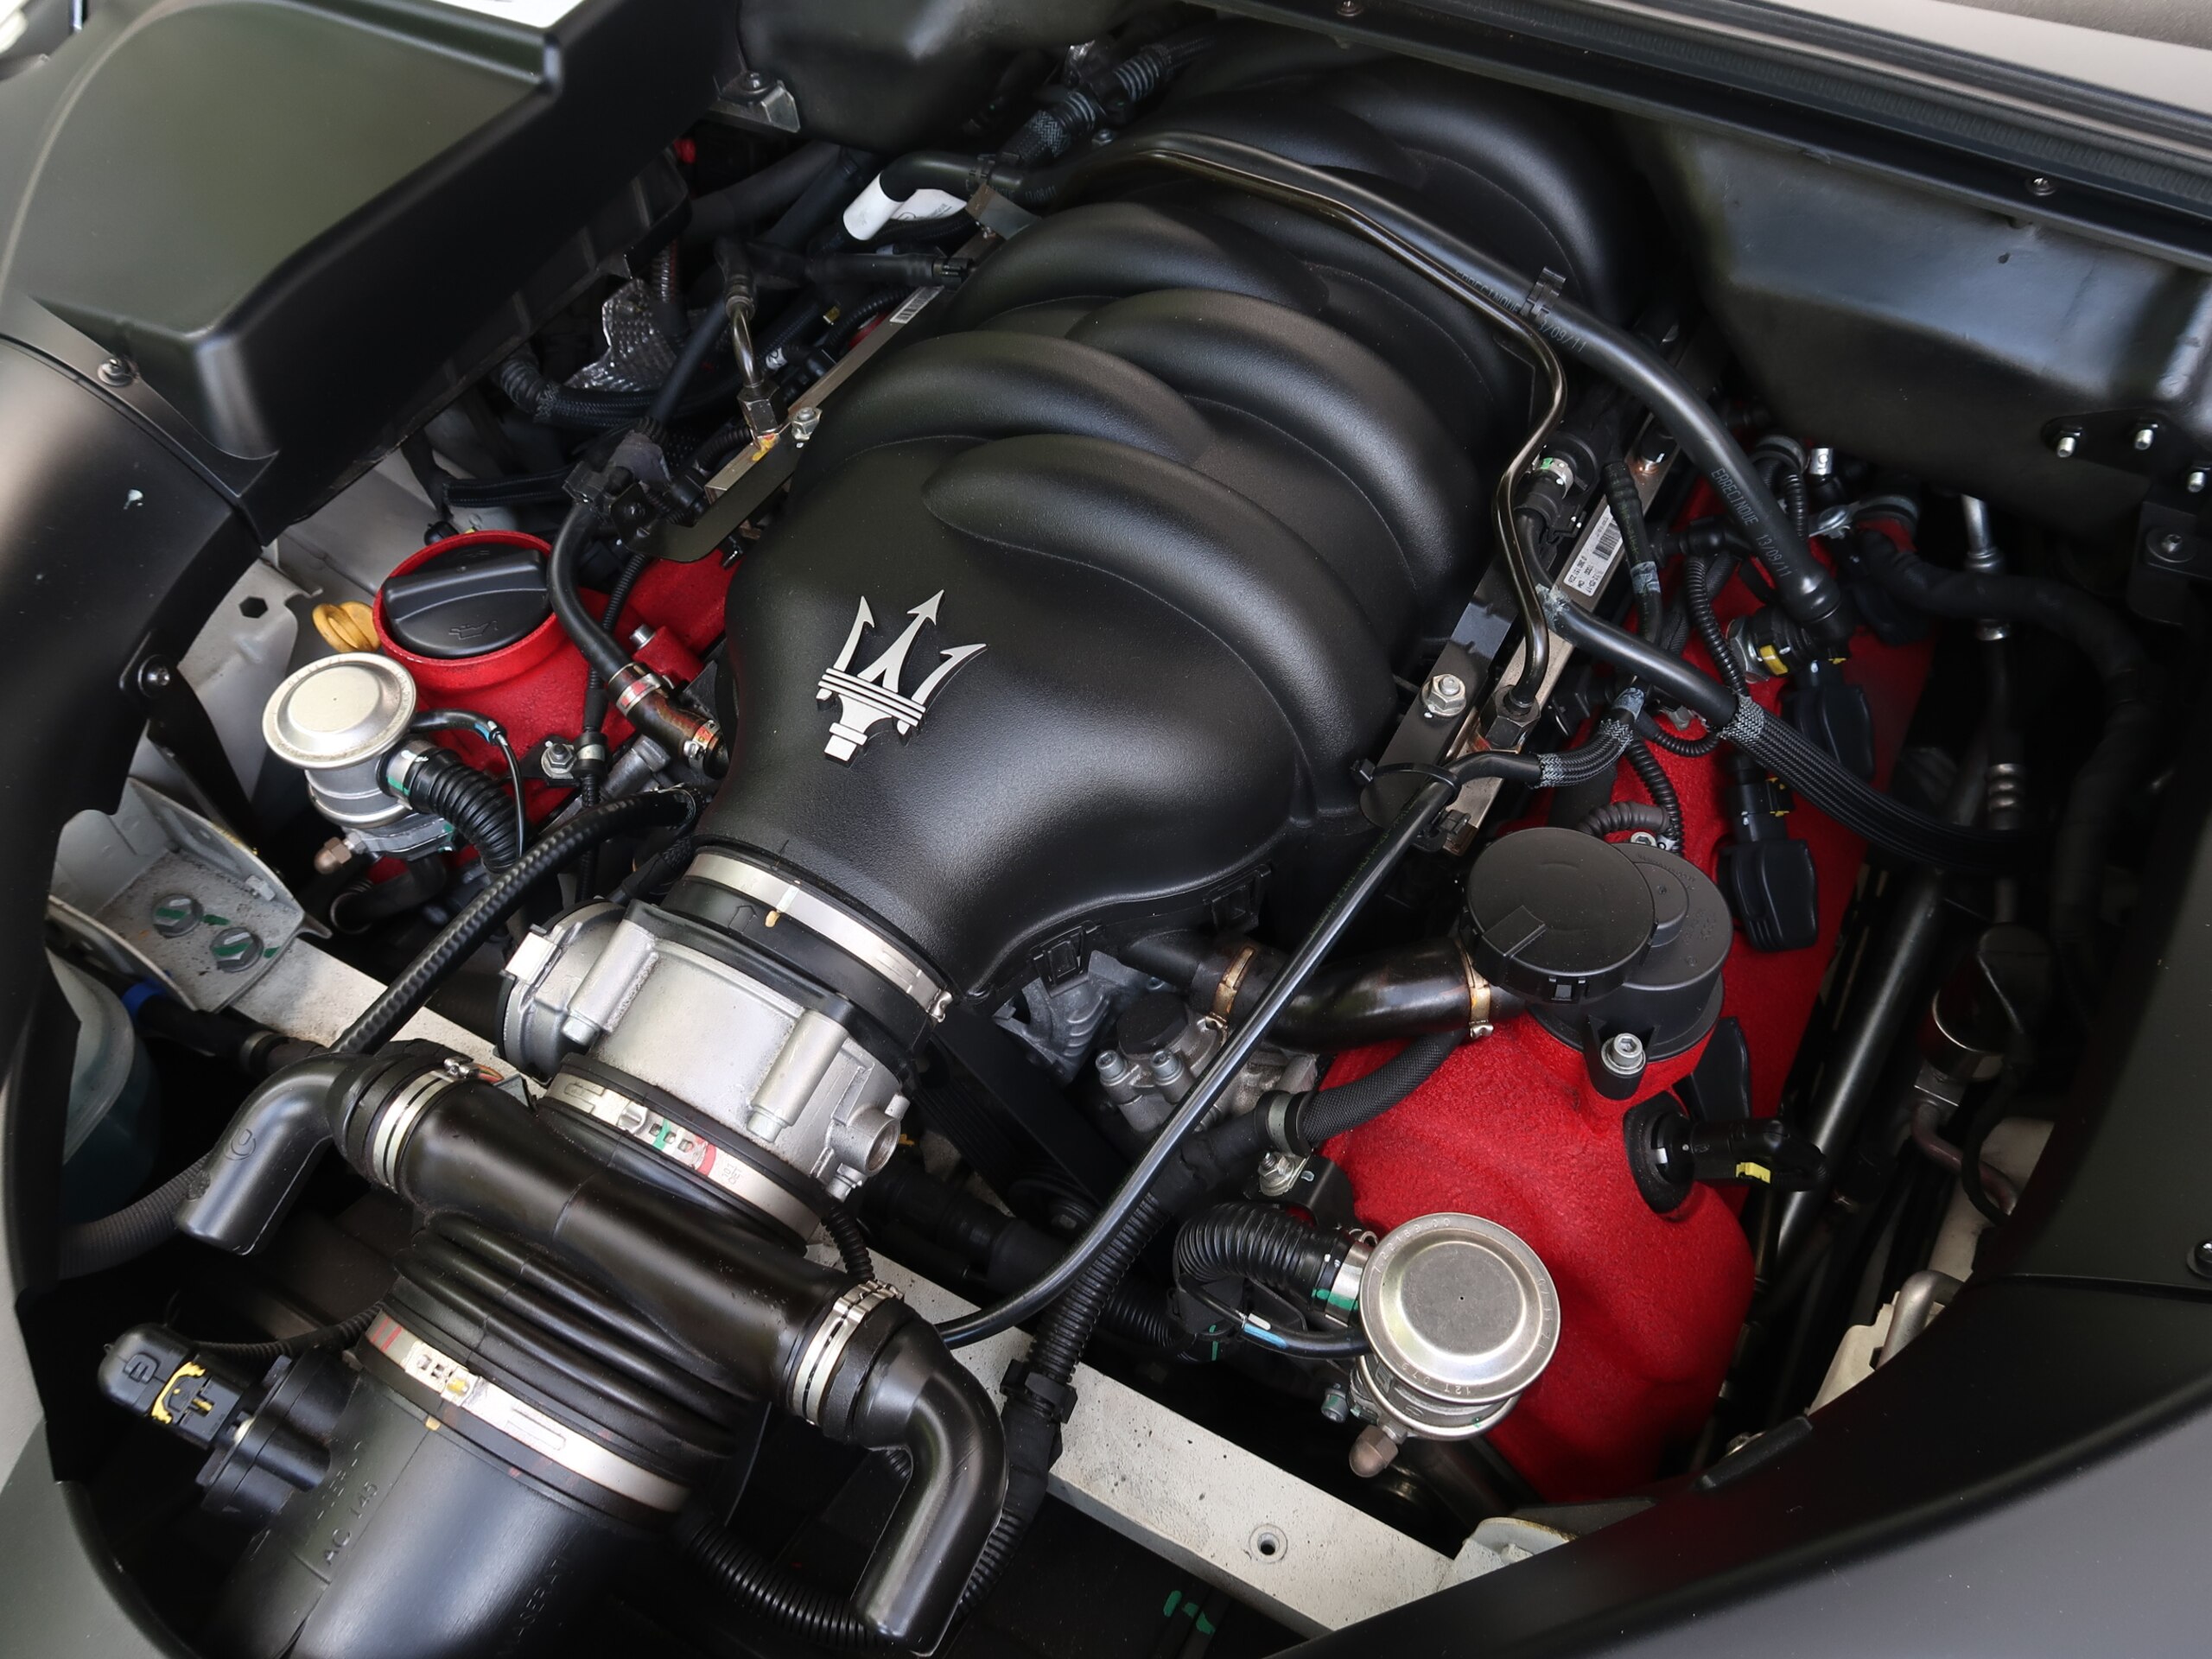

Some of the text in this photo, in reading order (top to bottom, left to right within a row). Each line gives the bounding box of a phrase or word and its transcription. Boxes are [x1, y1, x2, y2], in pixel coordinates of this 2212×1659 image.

[1538, 317, 1587, 353] 3/09/11
[1711, 467, 1792, 577] ERRECINQUE 13/09/11
